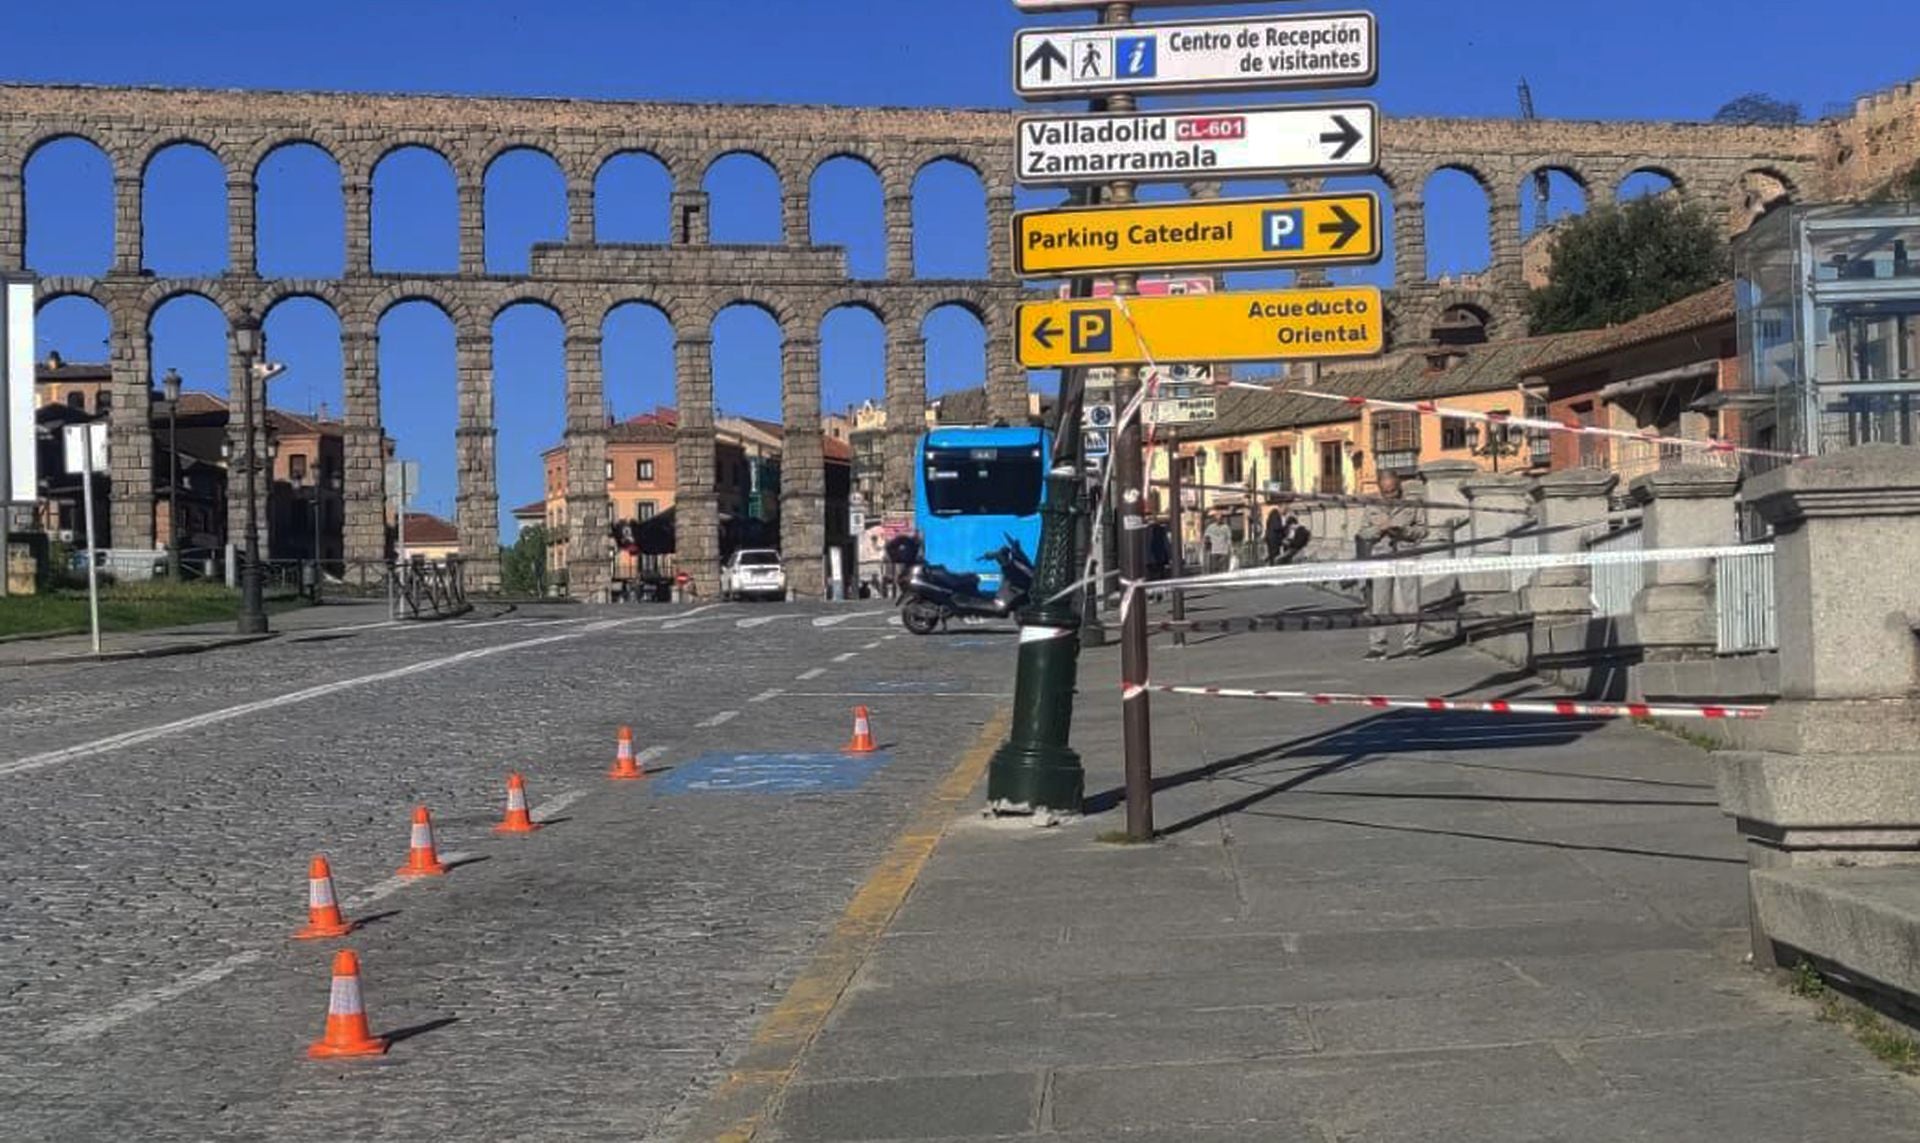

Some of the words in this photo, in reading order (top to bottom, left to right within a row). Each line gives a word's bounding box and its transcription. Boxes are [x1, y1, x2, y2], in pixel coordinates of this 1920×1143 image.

[1169, 31, 1231, 52] Centro
[1236, 29, 1260, 49] de
[1266, 25, 1361, 48] Recepción
[1240, 52, 1263, 73] de
[1269, 50, 1361, 71] visitantes
[1028, 118, 1167, 146] Valladolid
[1177, 118, 1244, 139] CL-601
[1028, 145, 1217, 173] Zamarramala
[1028, 228, 1119, 250] Parking
[1128, 221, 1233, 244] Catedral
[1270, 214, 1294, 246] P
[1248, 298, 1368, 319] Acueducto
[1079, 314, 1104, 348] P
[1277, 323, 1368, 345] Oriental
